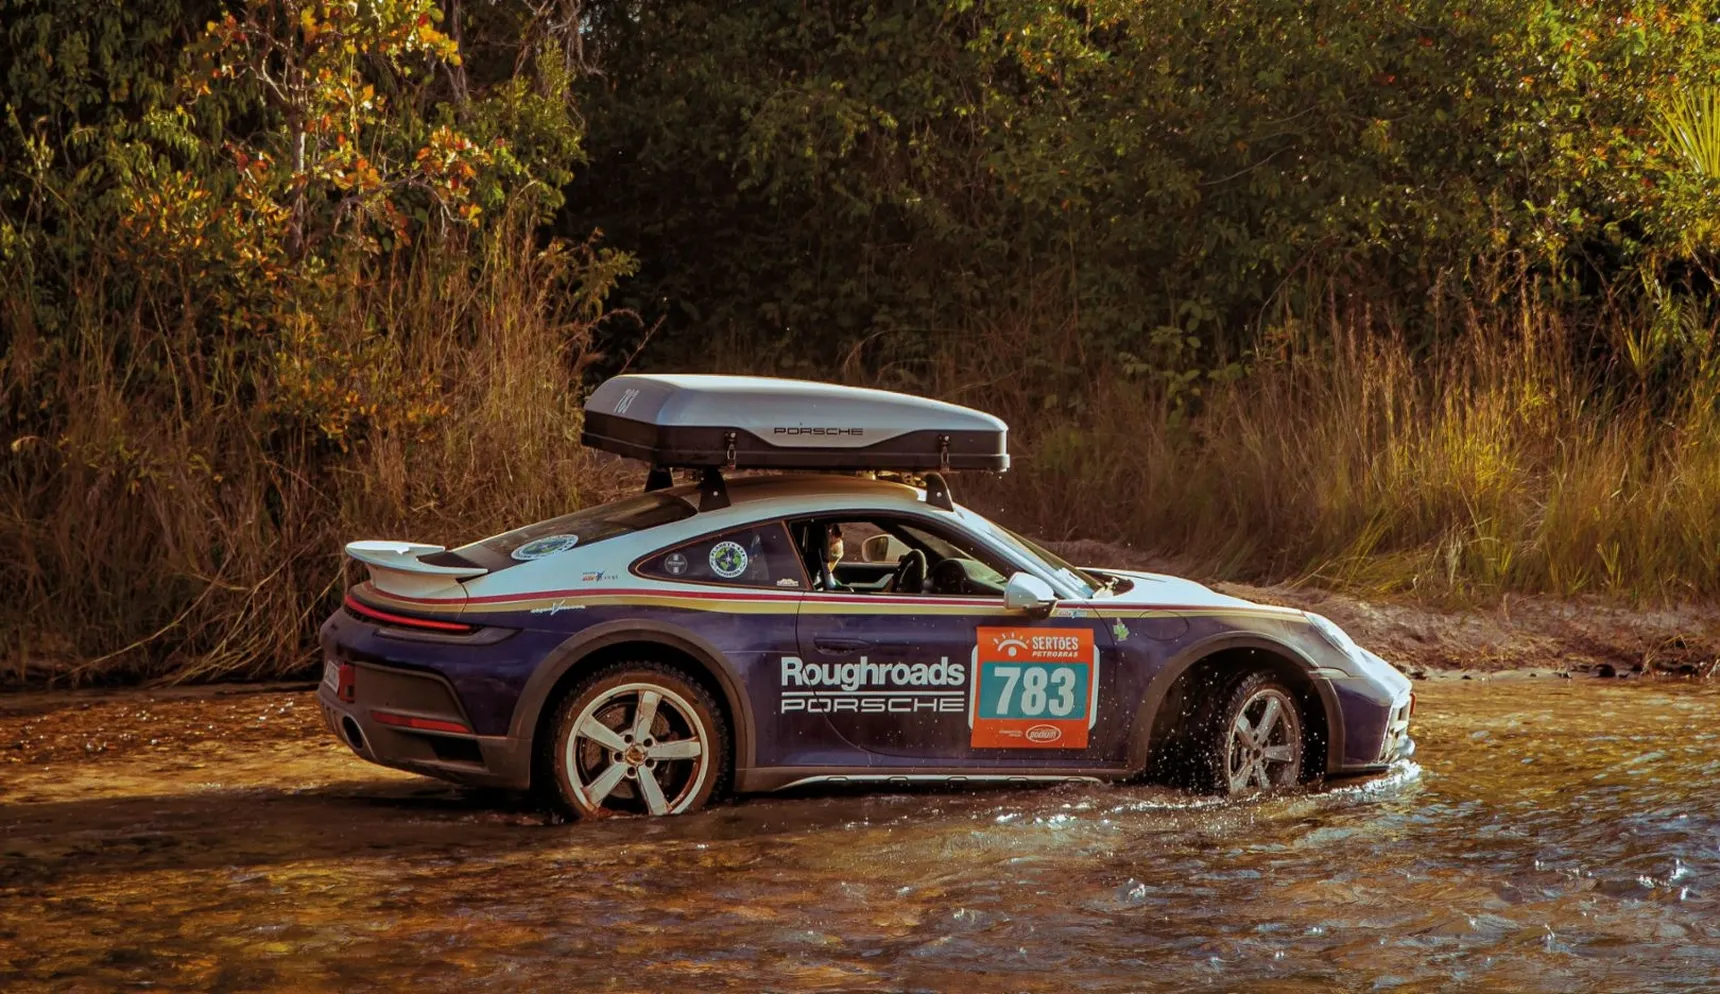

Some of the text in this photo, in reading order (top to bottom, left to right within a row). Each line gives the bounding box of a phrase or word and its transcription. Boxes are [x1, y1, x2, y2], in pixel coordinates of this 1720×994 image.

[613, 388, 640, 414] 783
[774, 427, 864, 436] PORSCHE
[781, 656, 966, 691] Roughroads
[994, 667, 1076, 717] 783
[781, 698, 965, 714] PORSCHE
